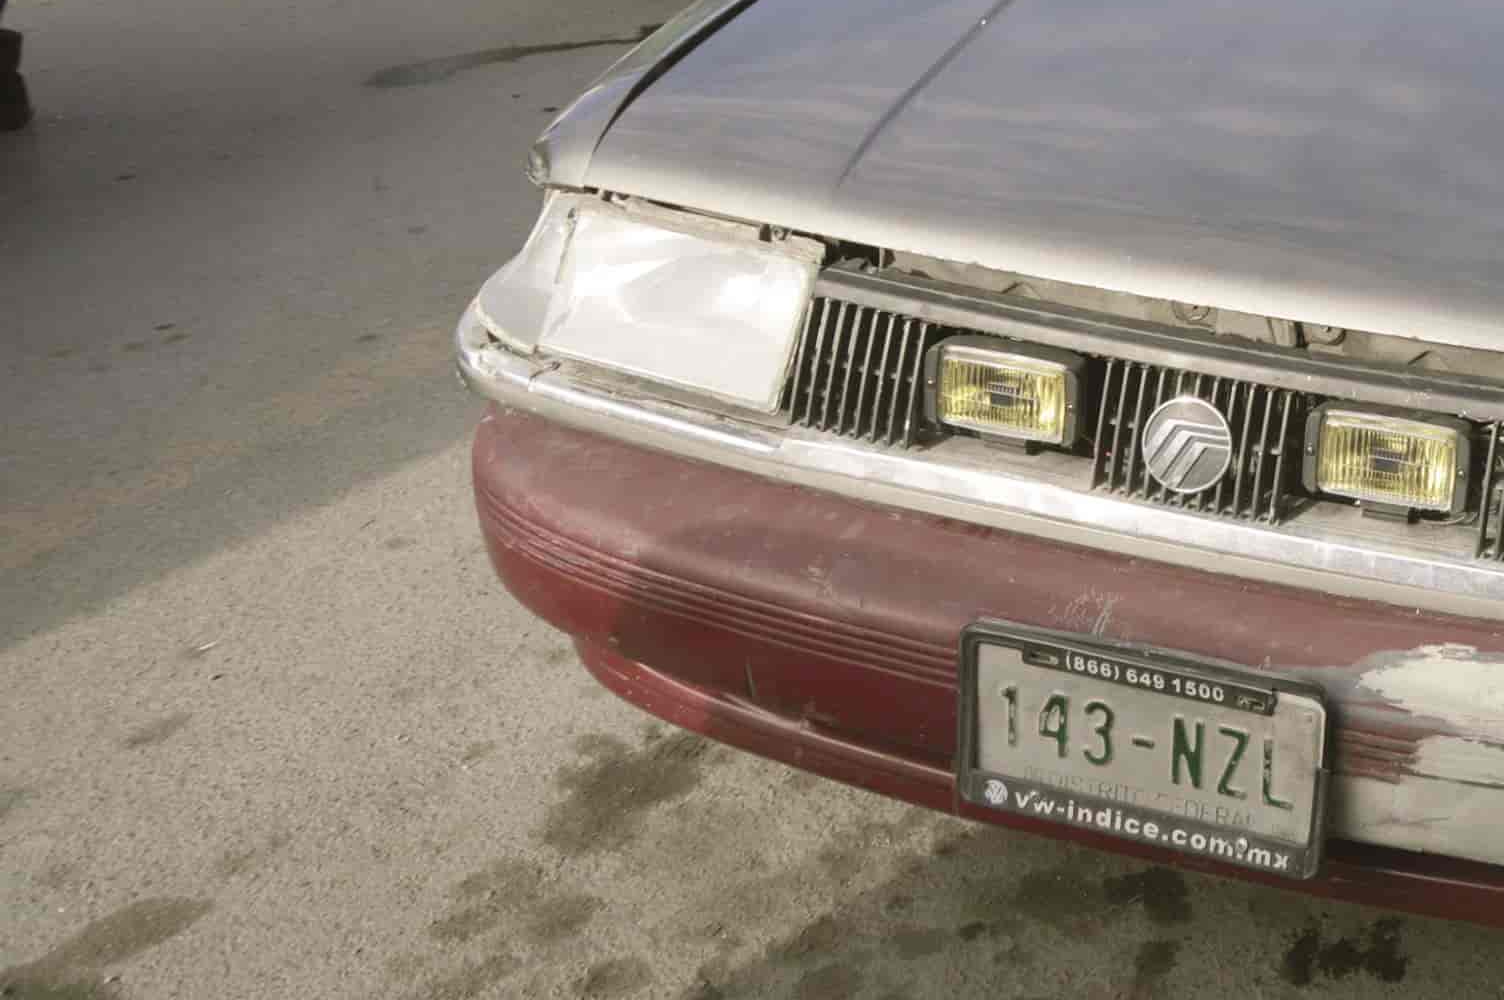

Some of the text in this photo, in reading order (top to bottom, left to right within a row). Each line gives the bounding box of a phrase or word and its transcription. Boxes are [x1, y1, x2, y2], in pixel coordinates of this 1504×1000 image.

[1065, 651, 1225, 703] (866) 649 1500
[1001, 685, 1294, 811] 143-NZL
